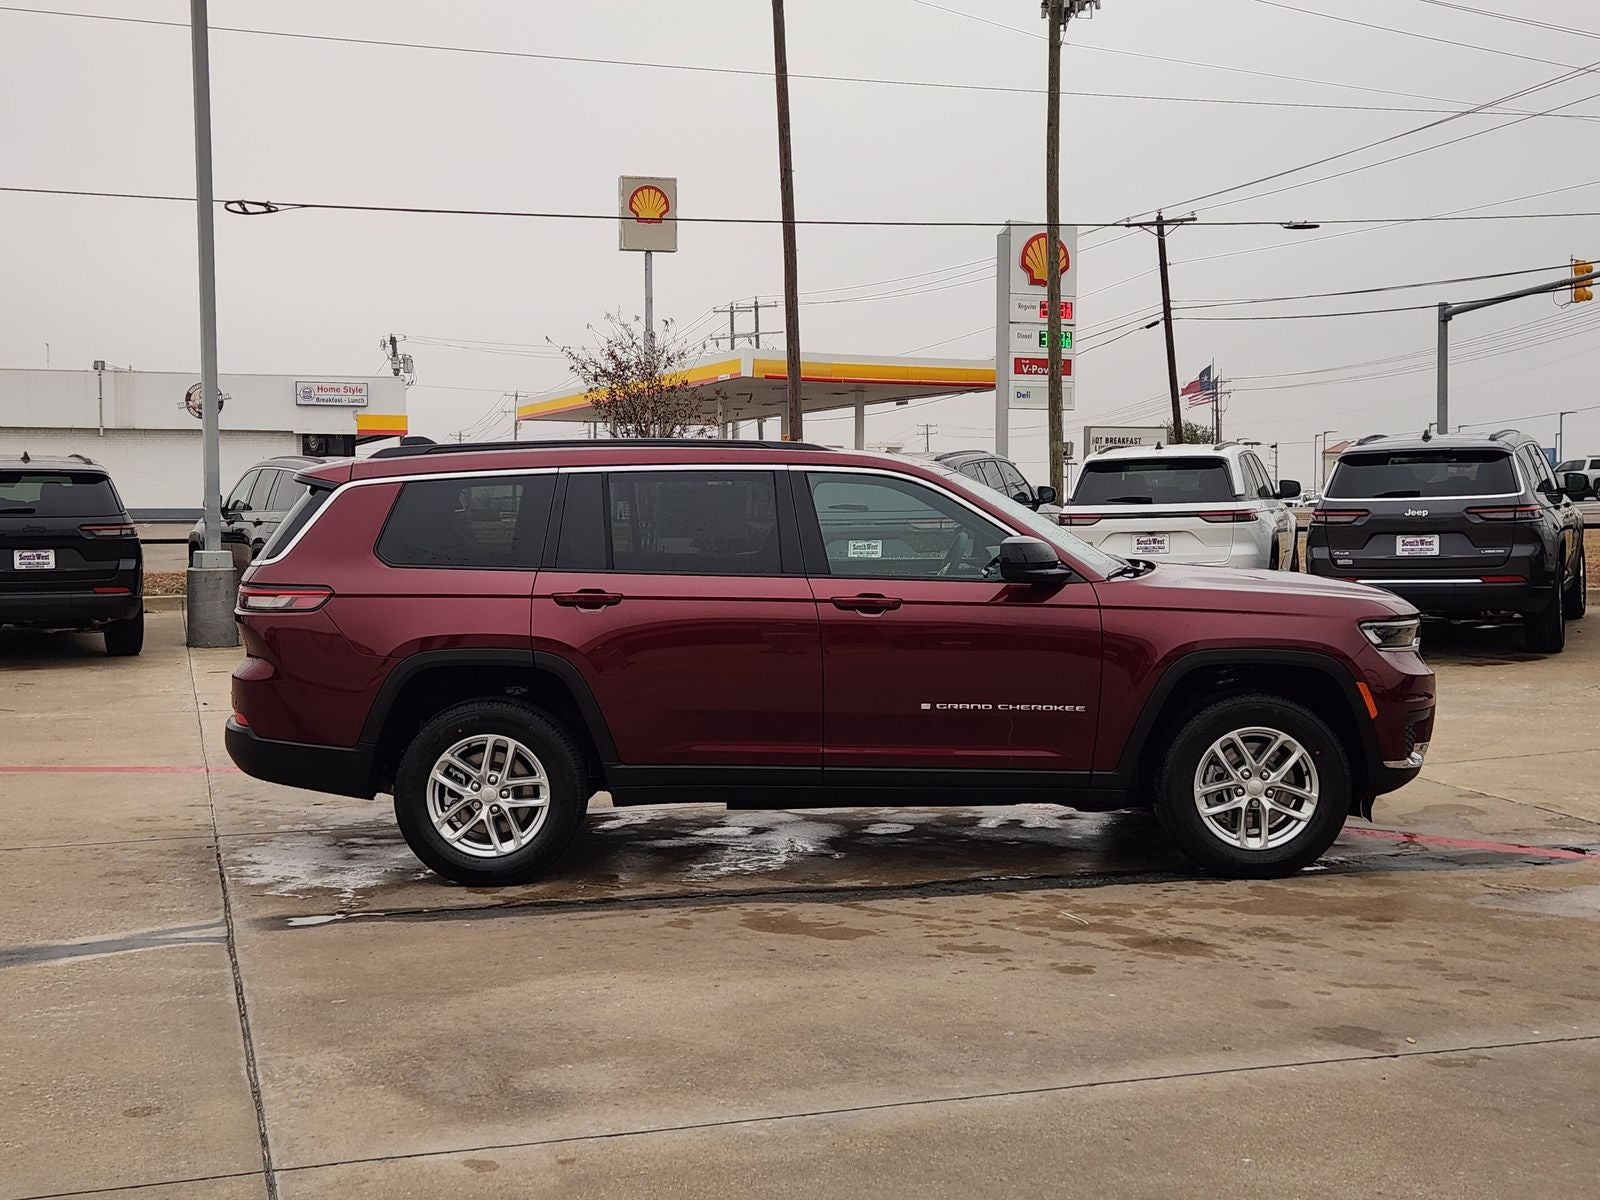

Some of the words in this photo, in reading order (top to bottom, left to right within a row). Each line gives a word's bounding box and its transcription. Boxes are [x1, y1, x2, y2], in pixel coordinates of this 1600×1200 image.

[1017, 302, 1037, 310] Regular
[1016, 332, 1033, 340] Diesel
[317, 385, 341, 394] Home
[343, 386, 363, 395] Style
[1016, 391, 1031, 399] Deli
[315, 396, 343, 404] Breakfast
[1105, 436, 1142, 445] BREAKFAST
[1404, 508, 1429, 517] Jeep
[997, 703, 1087, 712] CHEROKEE
